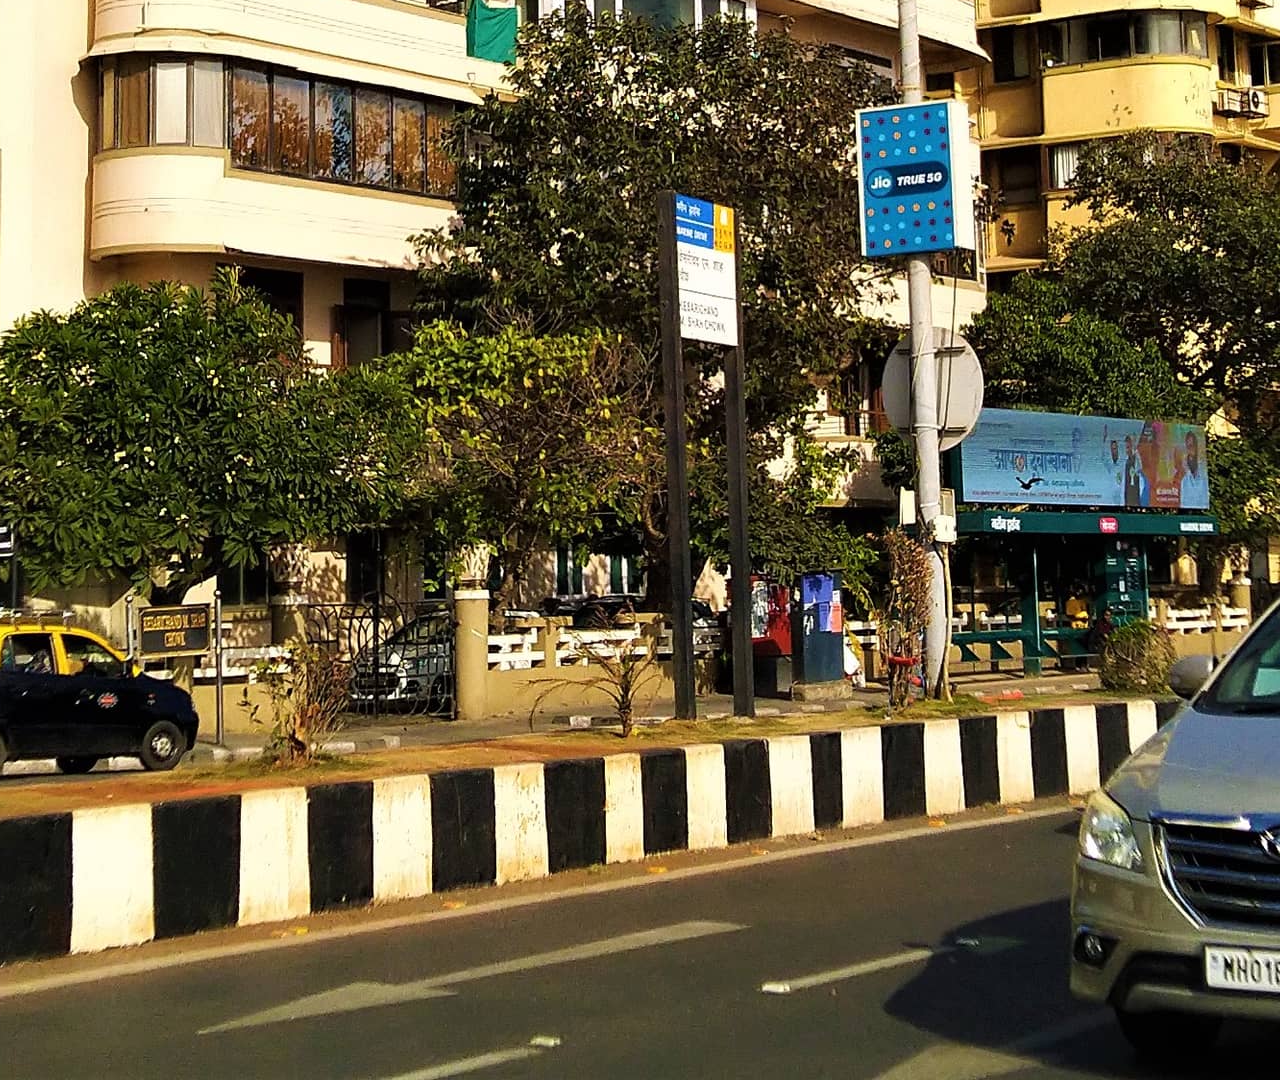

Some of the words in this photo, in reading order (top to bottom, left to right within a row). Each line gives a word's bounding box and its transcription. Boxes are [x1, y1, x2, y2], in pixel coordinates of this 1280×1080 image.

[871, 175, 891, 189] Jio
[897, 173, 926, 186] TRUE
[926, 171, 942, 184] 5G
